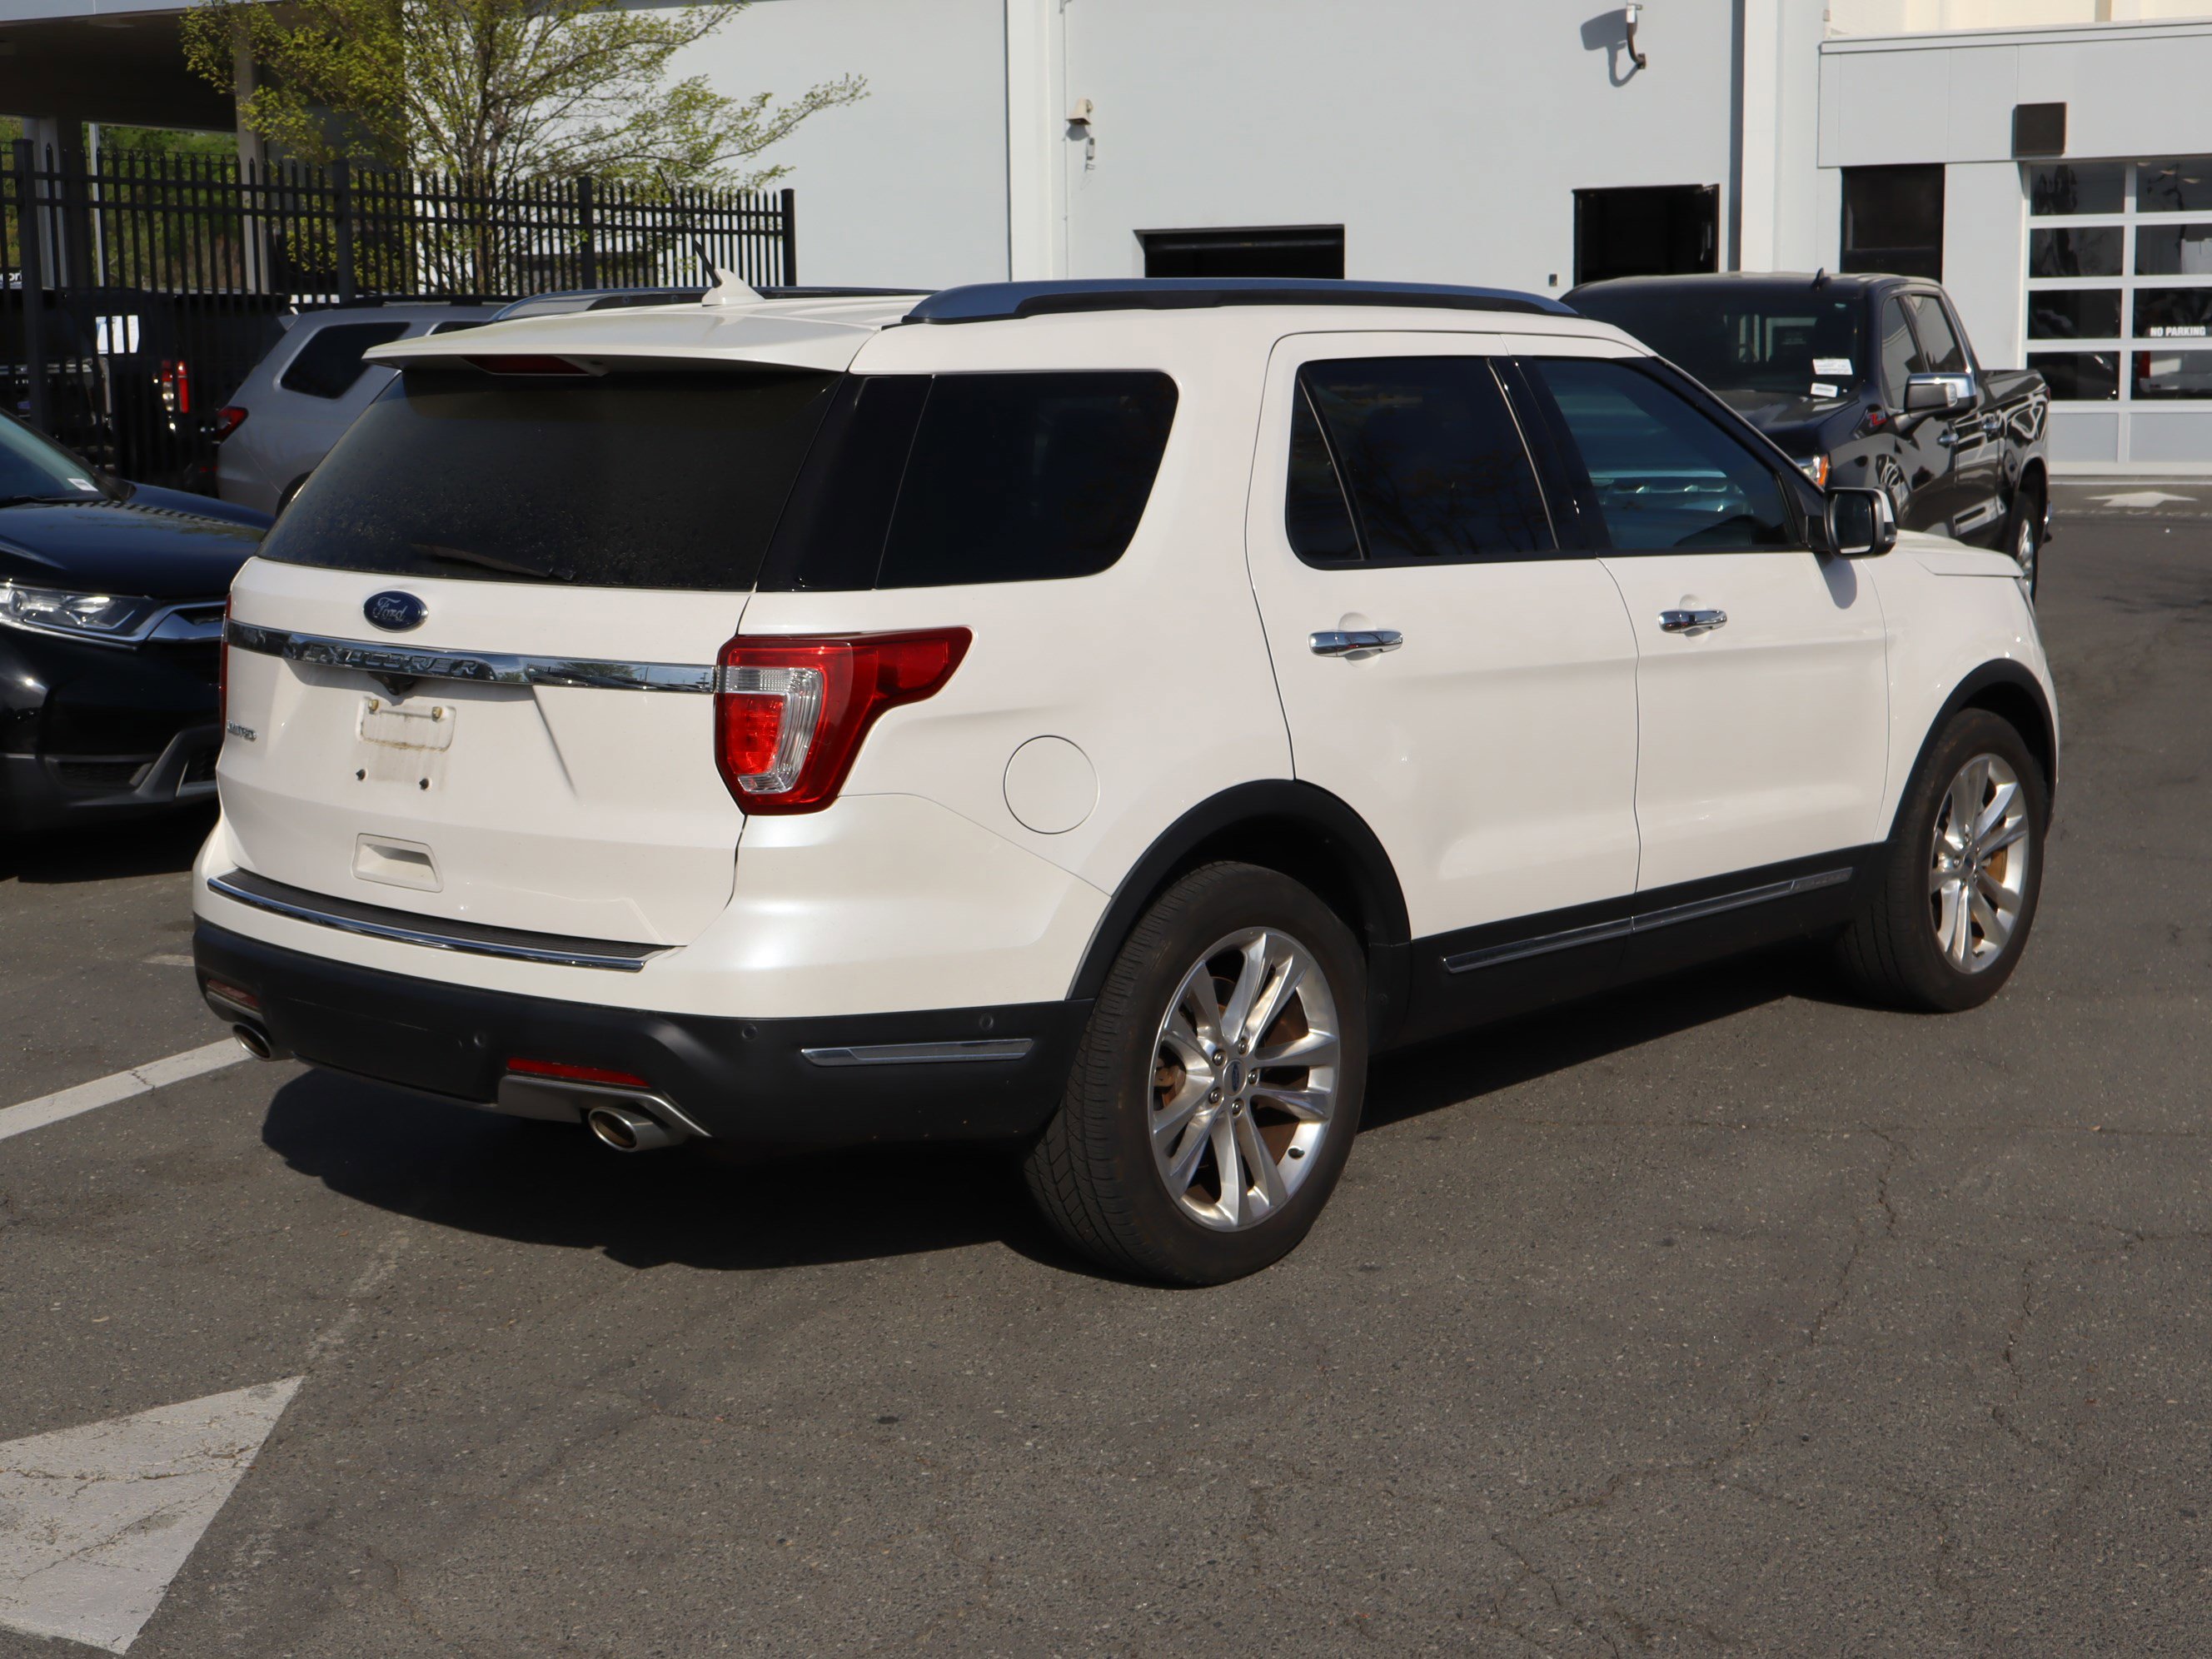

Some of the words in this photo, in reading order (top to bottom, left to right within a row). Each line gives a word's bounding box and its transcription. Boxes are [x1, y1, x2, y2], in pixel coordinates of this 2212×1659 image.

[2150, 326, 2164, 337] NO
[2165, 325, 2206, 337] PARKING
[371, 596, 408, 621] Ford
[302, 645, 479, 677] EXPLORER
